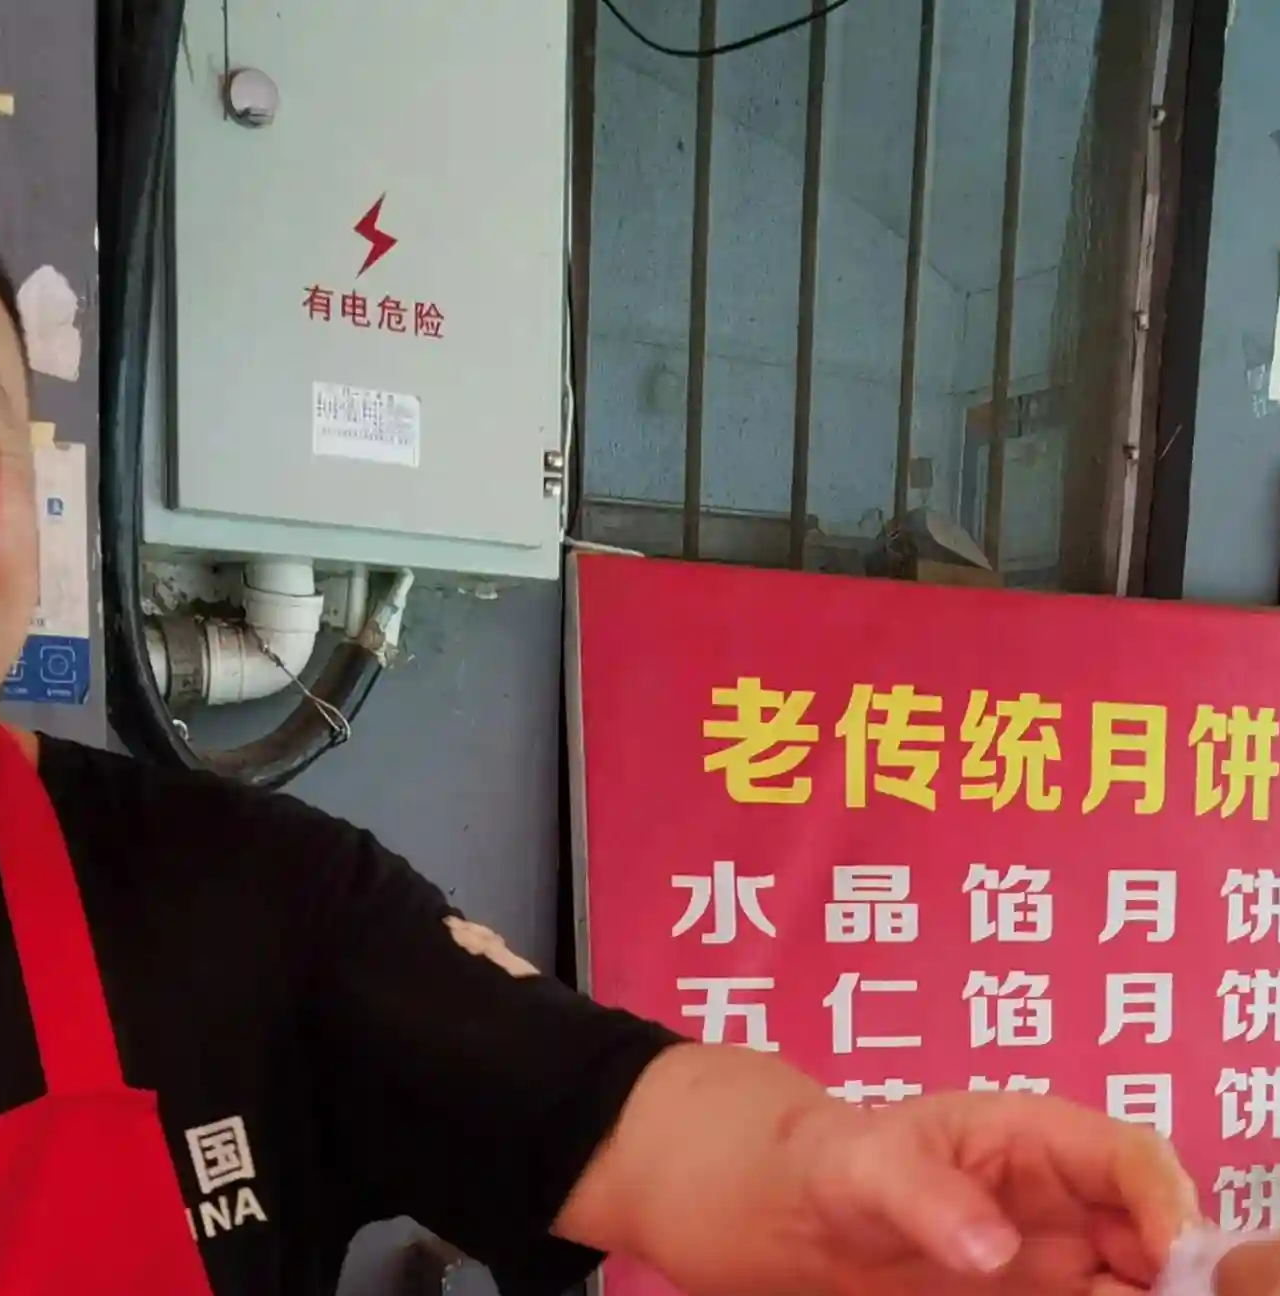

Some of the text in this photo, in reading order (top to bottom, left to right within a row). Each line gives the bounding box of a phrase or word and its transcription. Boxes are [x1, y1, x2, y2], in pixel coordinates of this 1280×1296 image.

[301, 283, 446, 339] 有电危险
[184, 1115, 255, 1195] 国
